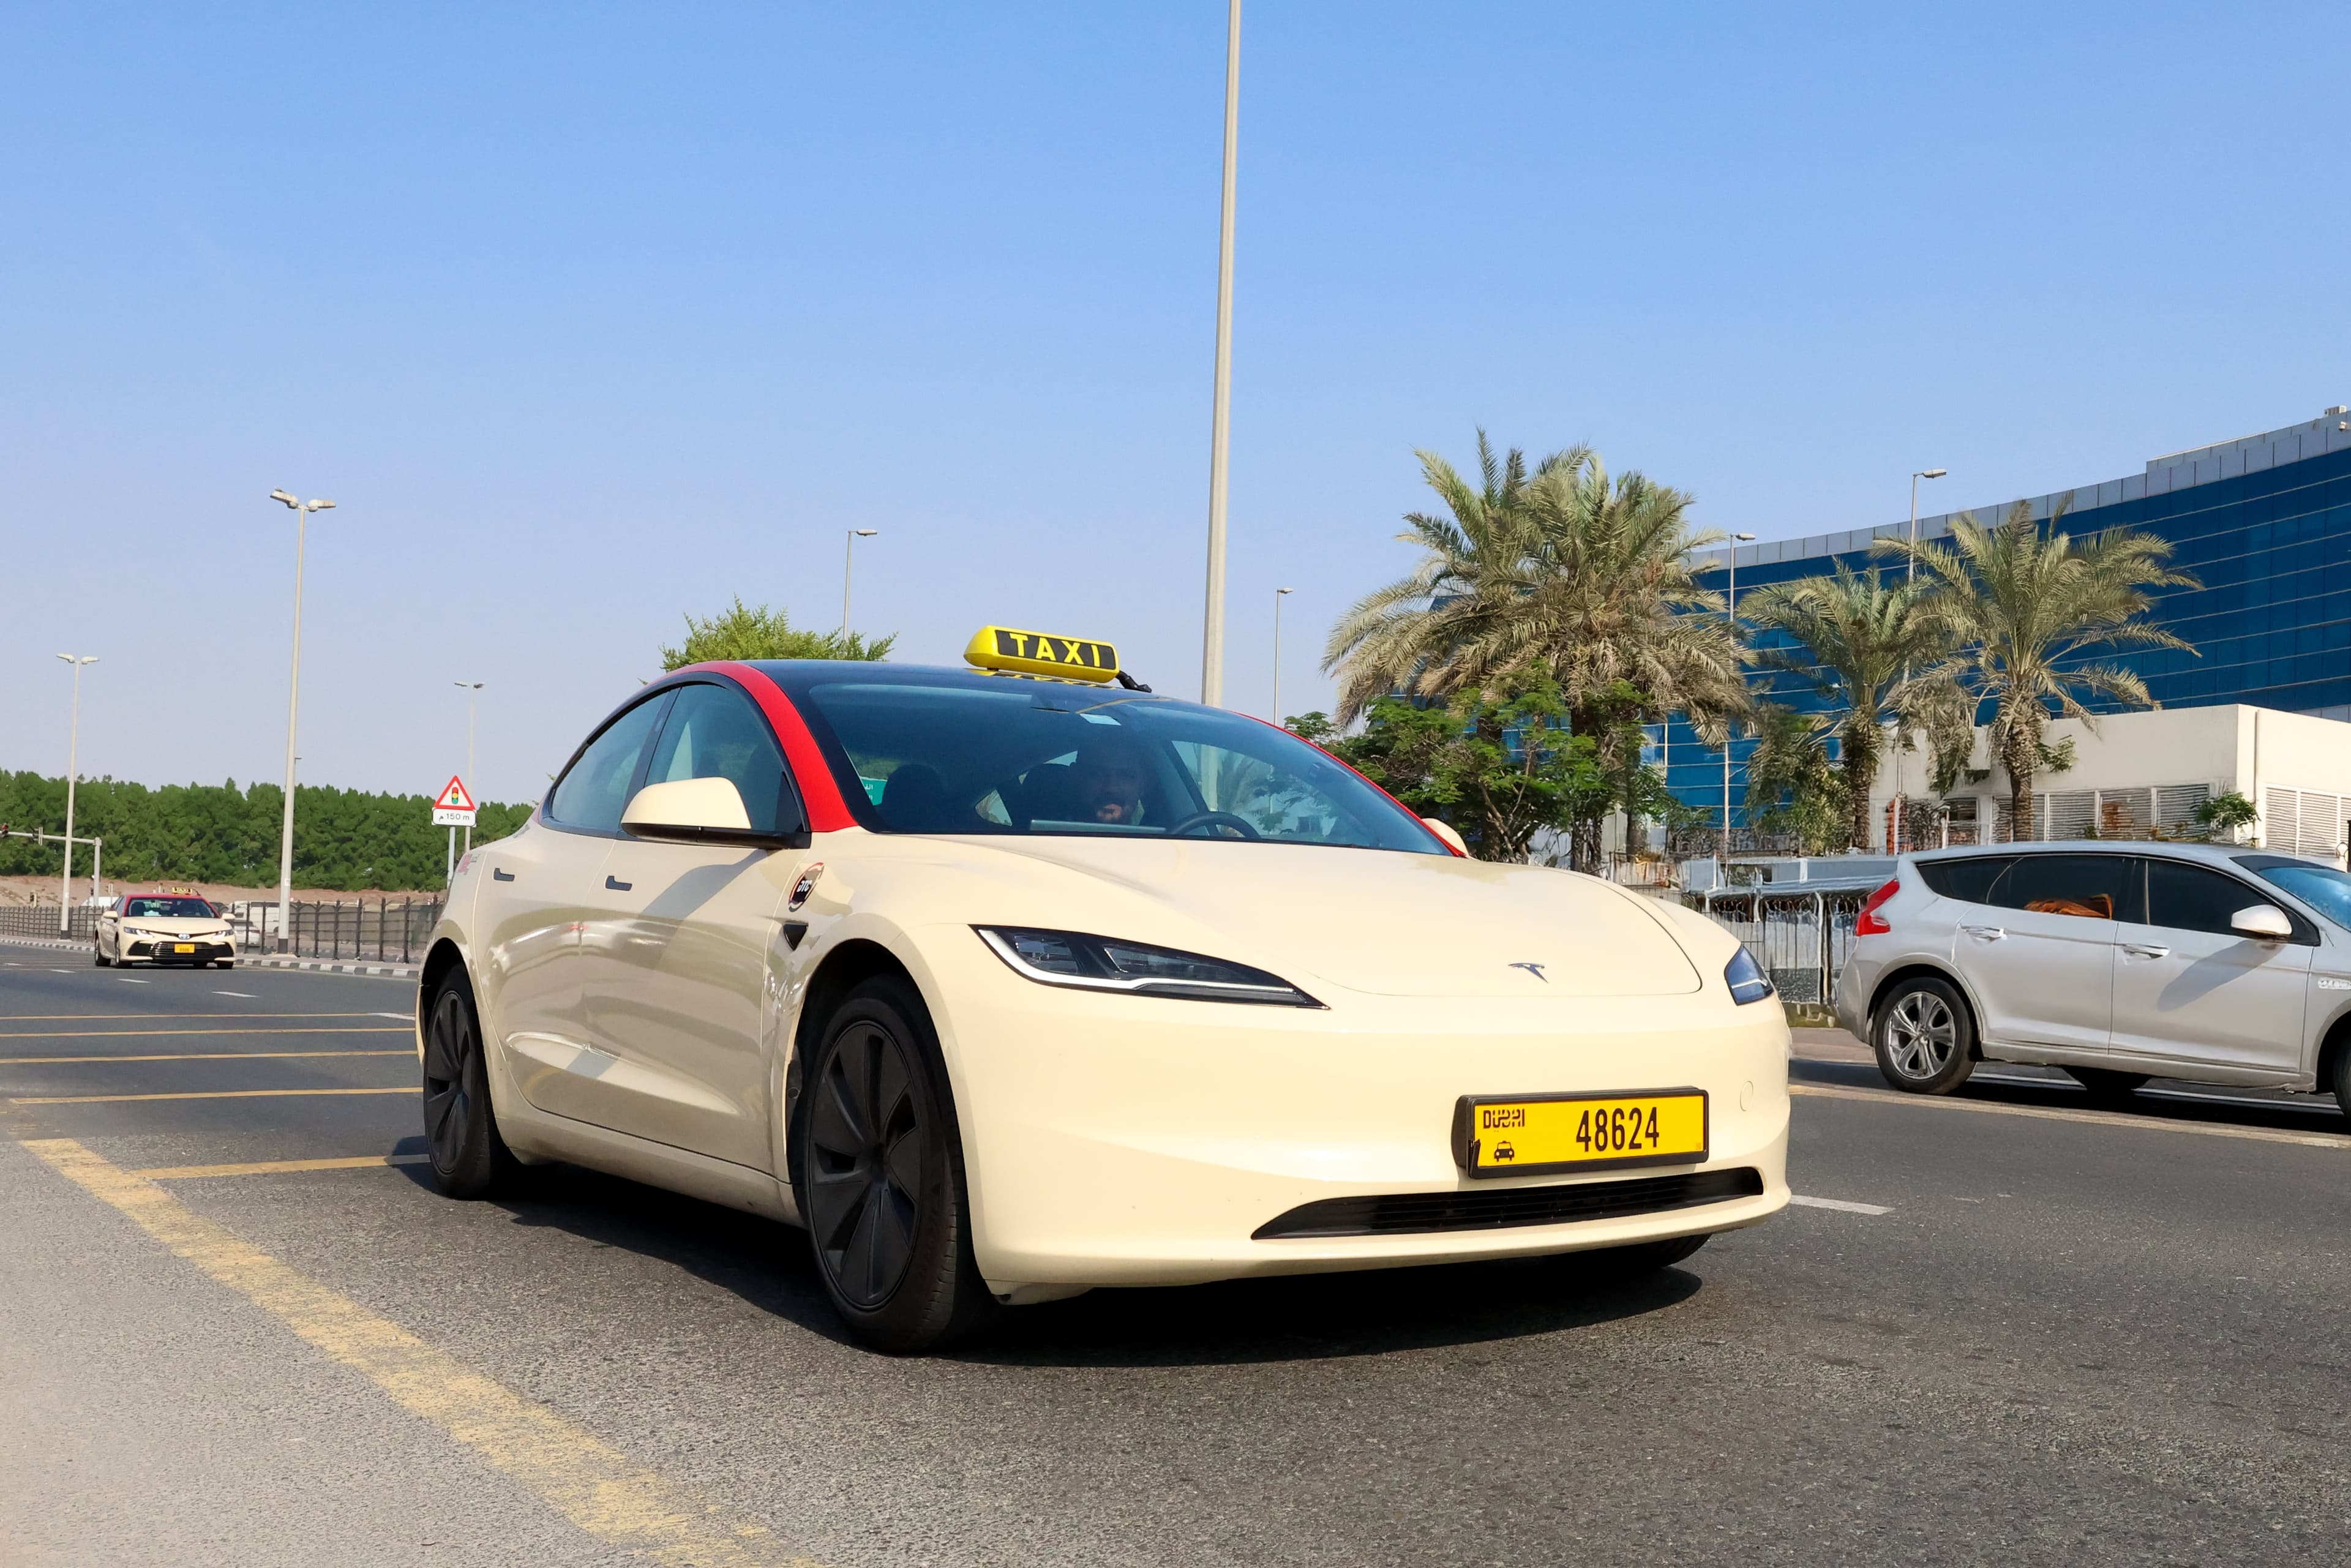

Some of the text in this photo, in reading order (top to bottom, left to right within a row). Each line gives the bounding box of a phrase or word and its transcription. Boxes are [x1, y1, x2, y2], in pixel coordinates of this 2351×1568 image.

[1008, 632, 1101, 667] TAXI
[797, 880, 812, 892] DTC
[1575, 1106, 1660, 1152] 48624
